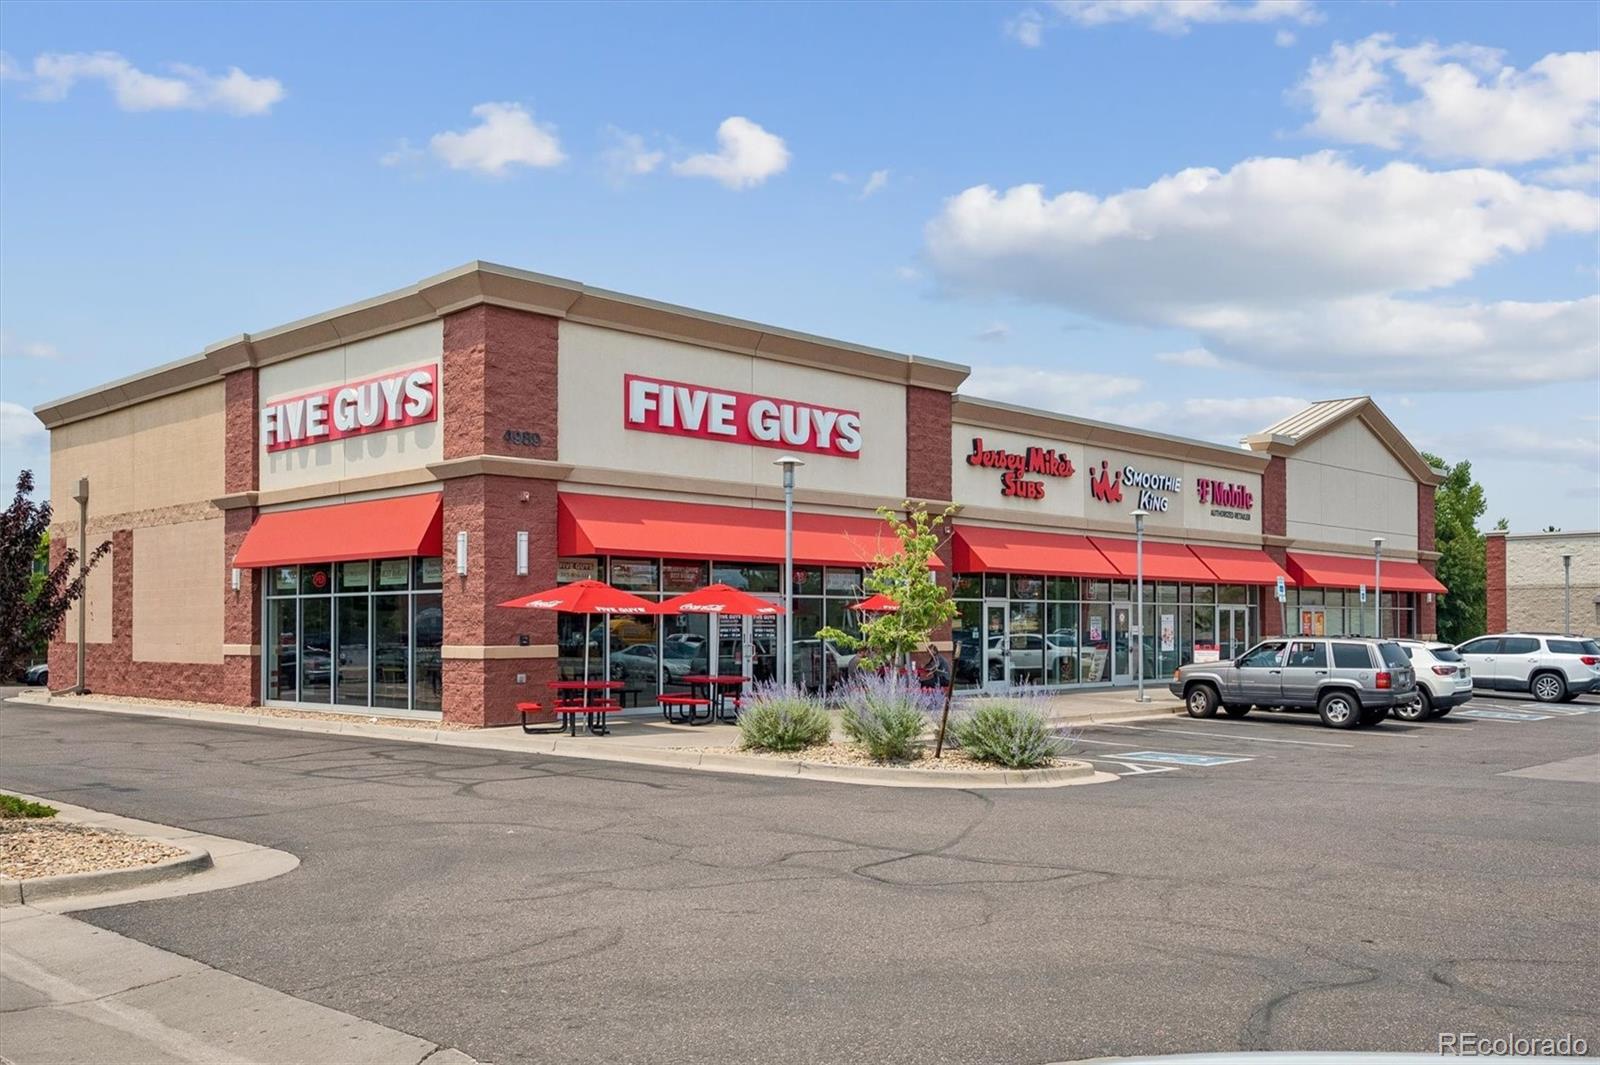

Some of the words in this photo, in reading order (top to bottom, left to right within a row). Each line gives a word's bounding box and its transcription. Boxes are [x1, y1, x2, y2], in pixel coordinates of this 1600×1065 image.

[261, 395, 329, 446] FIVE
[333, 371, 434, 432] GUYS
[629, 380, 737, 436] FIVE
[748, 400, 864, 452] GUYS
[966, 437, 1026, 480] Jersey
[1025, 447, 1075, 478] Mike's
[1123, 465, 1182, 494] SMOOTHIE
[1211, 480, 1253, 510] Mobile
[1211, 509, 1234, 519] AUTHORIZED
[1234, 512, 1251, 521] RETAILER
